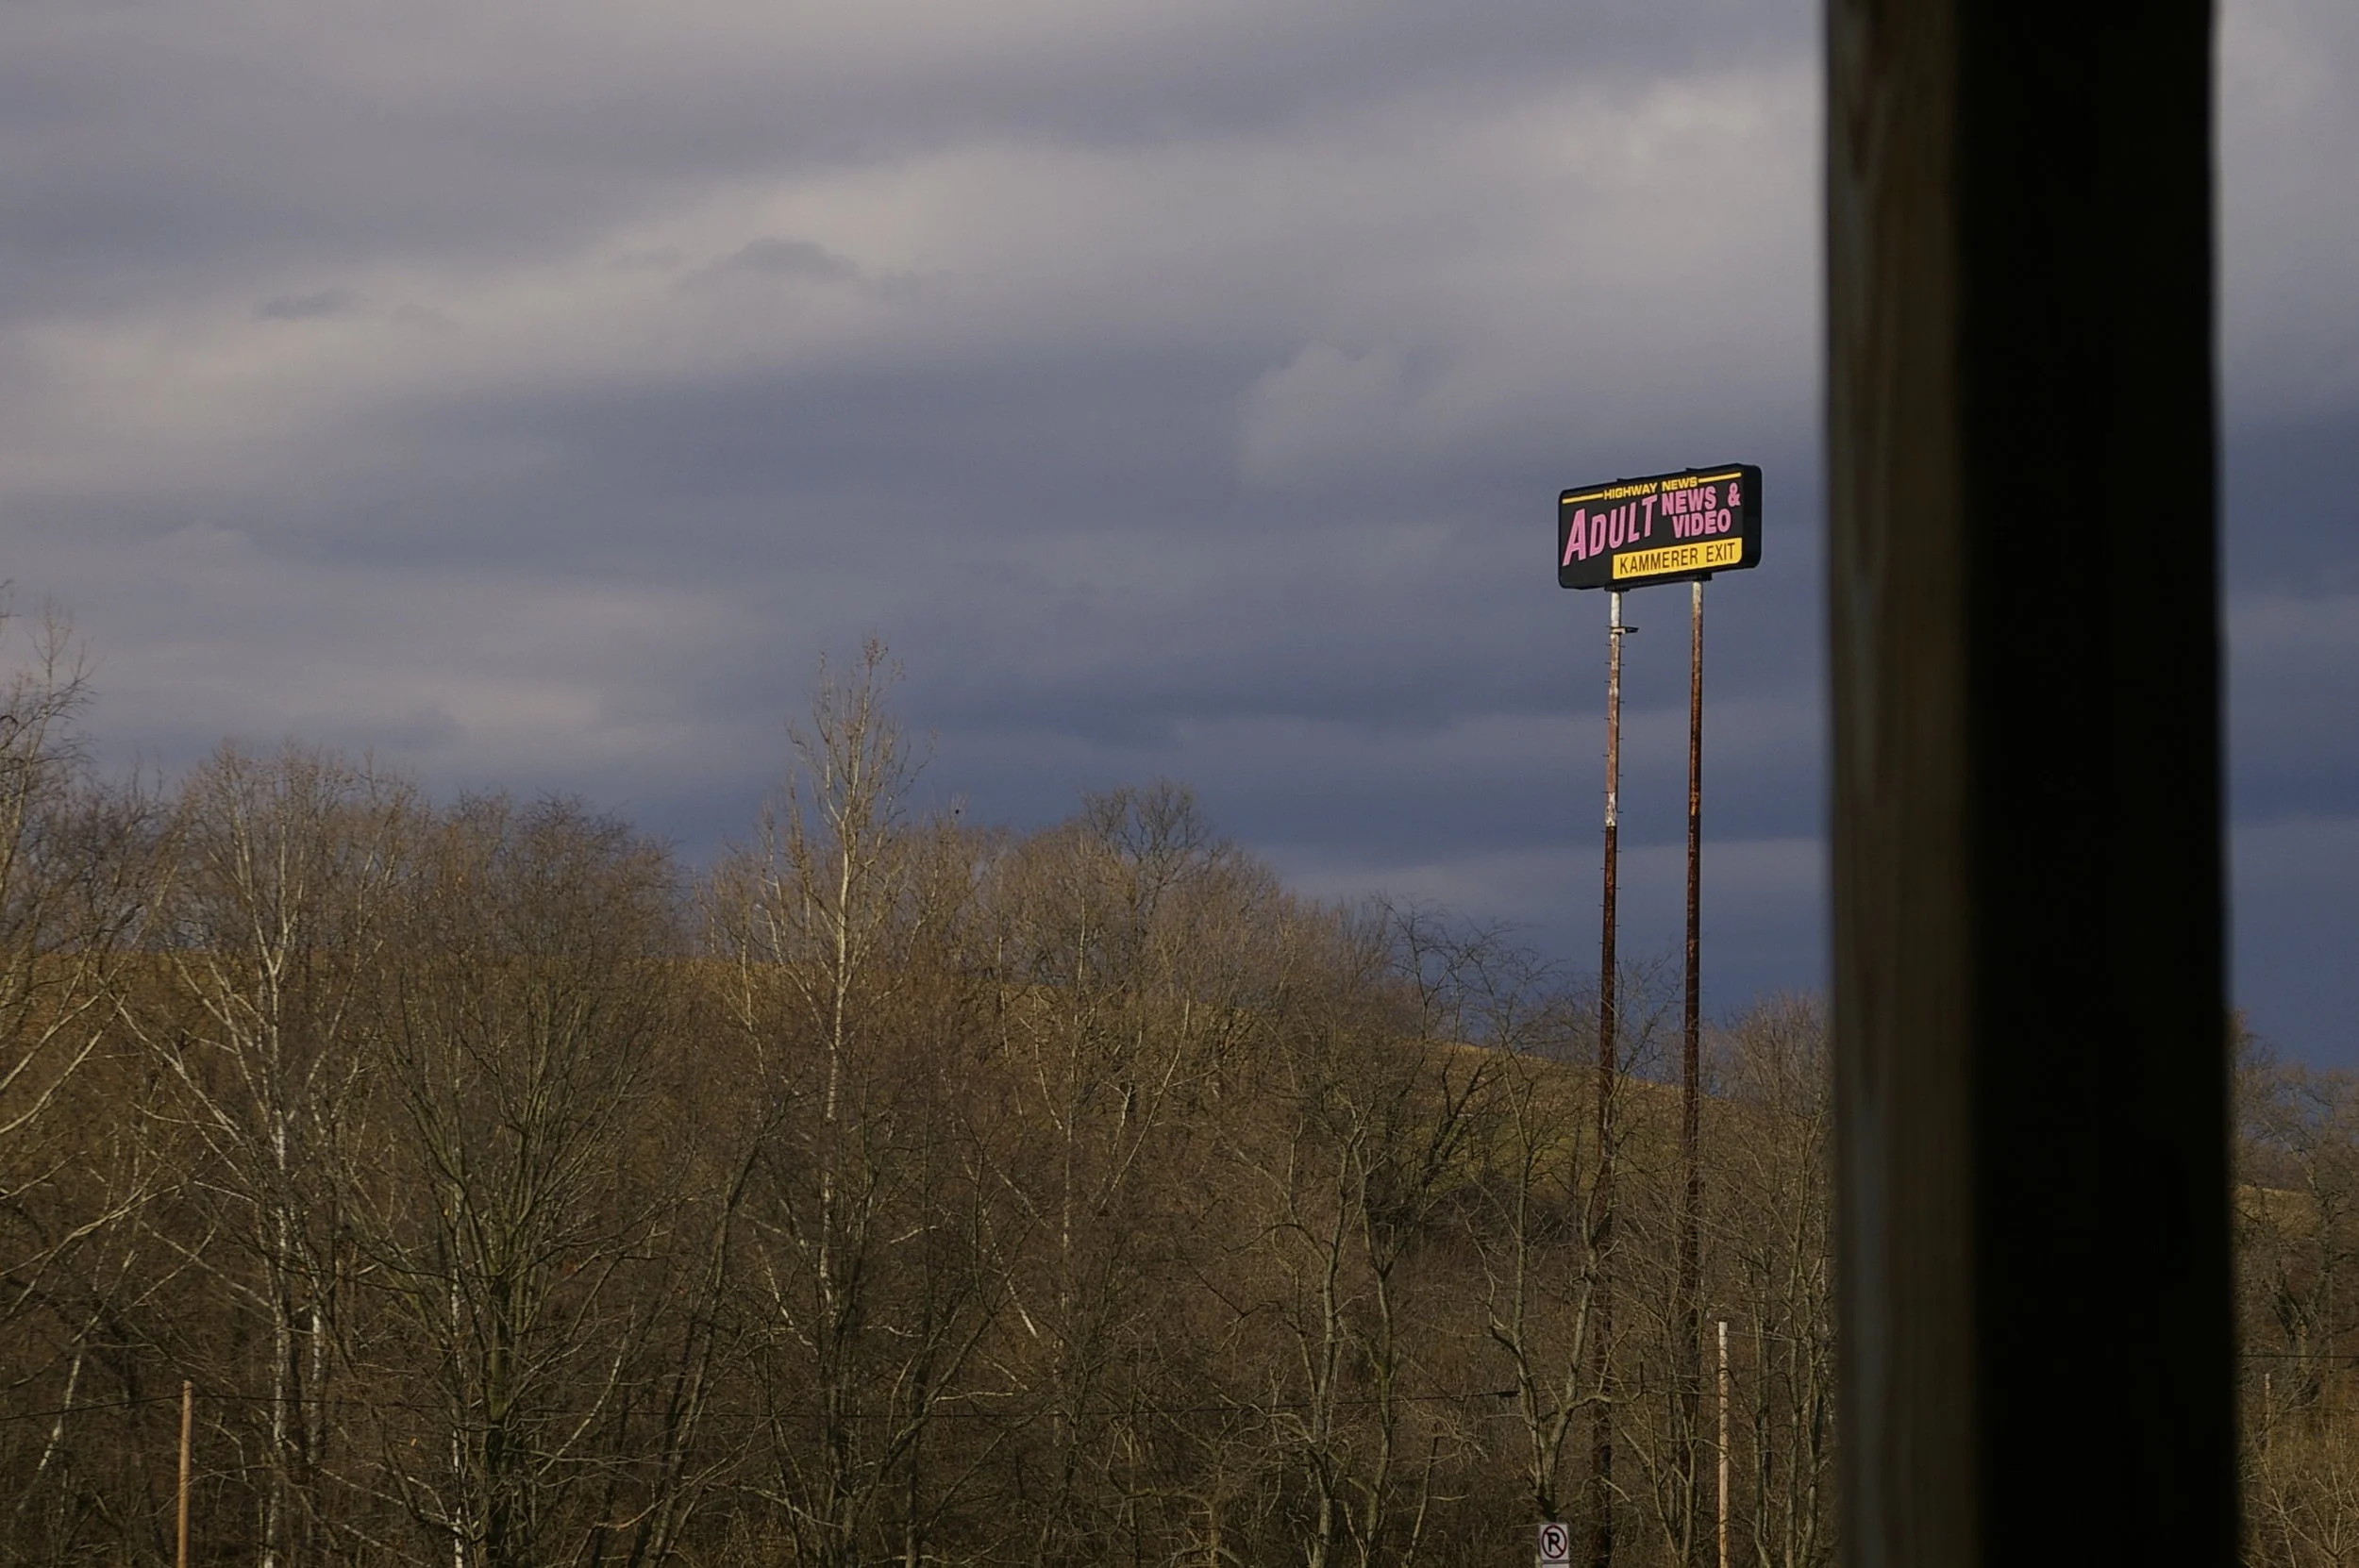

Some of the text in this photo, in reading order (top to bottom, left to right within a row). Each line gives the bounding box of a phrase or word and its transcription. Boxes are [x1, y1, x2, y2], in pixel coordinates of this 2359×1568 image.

[1604, 476, 1698, 500] HIGHWAY NEWS
[1662, 482, 1741, 516] NEWS &
[1563, 494, 1658, 566] ADULT
[1672, 509, 1732, 539] VIDEO
[1620, 542, 1735, 575] KAMMERER EXIT
